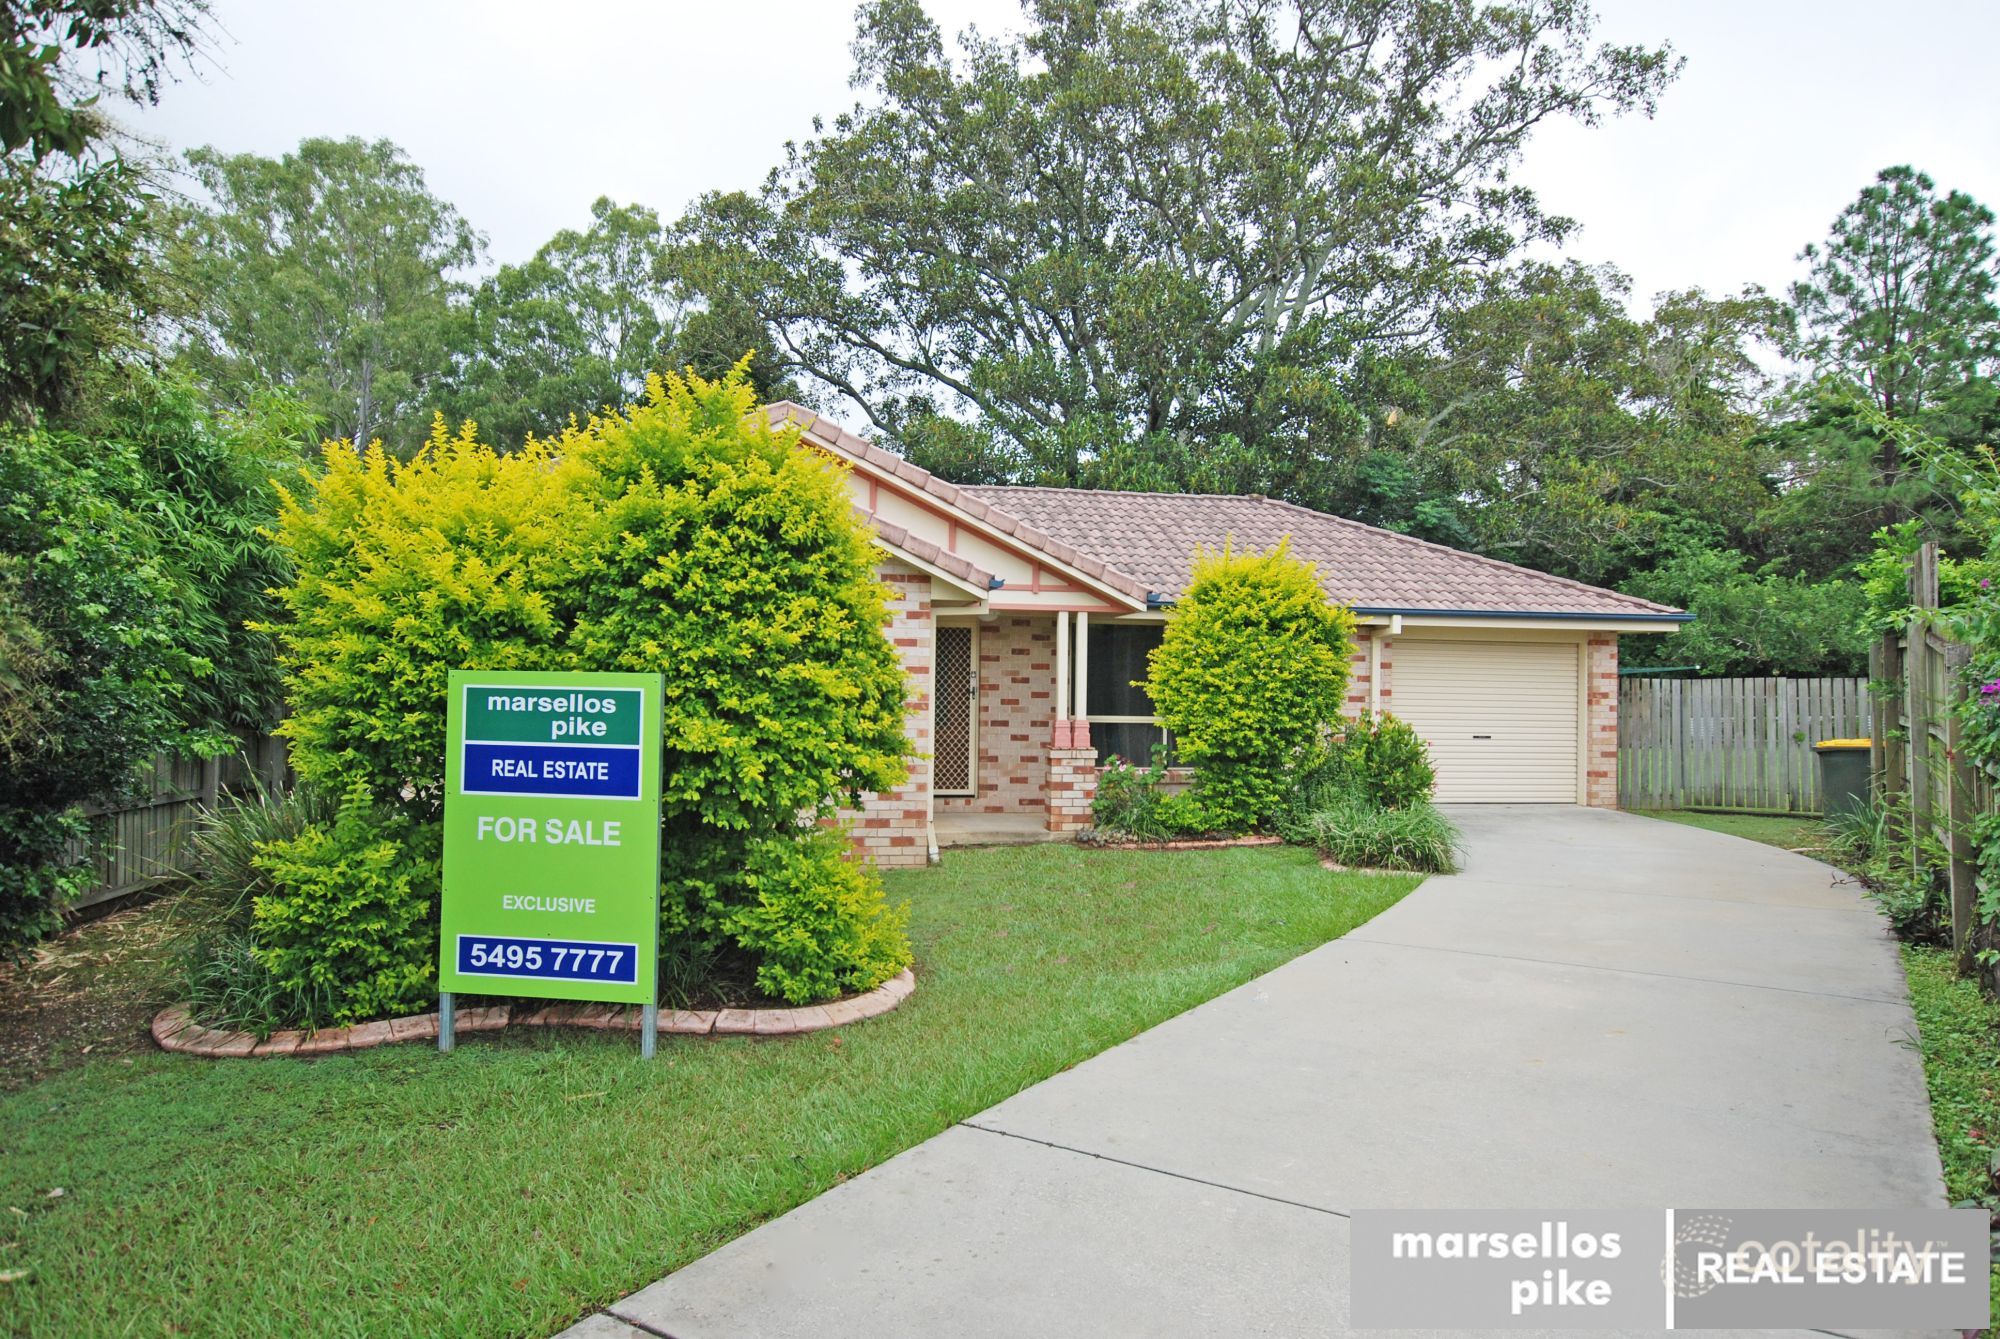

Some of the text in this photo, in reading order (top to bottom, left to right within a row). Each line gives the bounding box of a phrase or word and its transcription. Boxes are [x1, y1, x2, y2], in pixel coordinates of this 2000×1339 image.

[487, 693, 617, 714] marsellos
[551, 716, 608, 740] pike
[491, 759, 609, 780] REAL ESTATE
[477, 816, 621, 846] FOR SALE
[502, 895, 596, 913] EXCLUSIVE
[470, 943, 624, 974] 5495 7777
